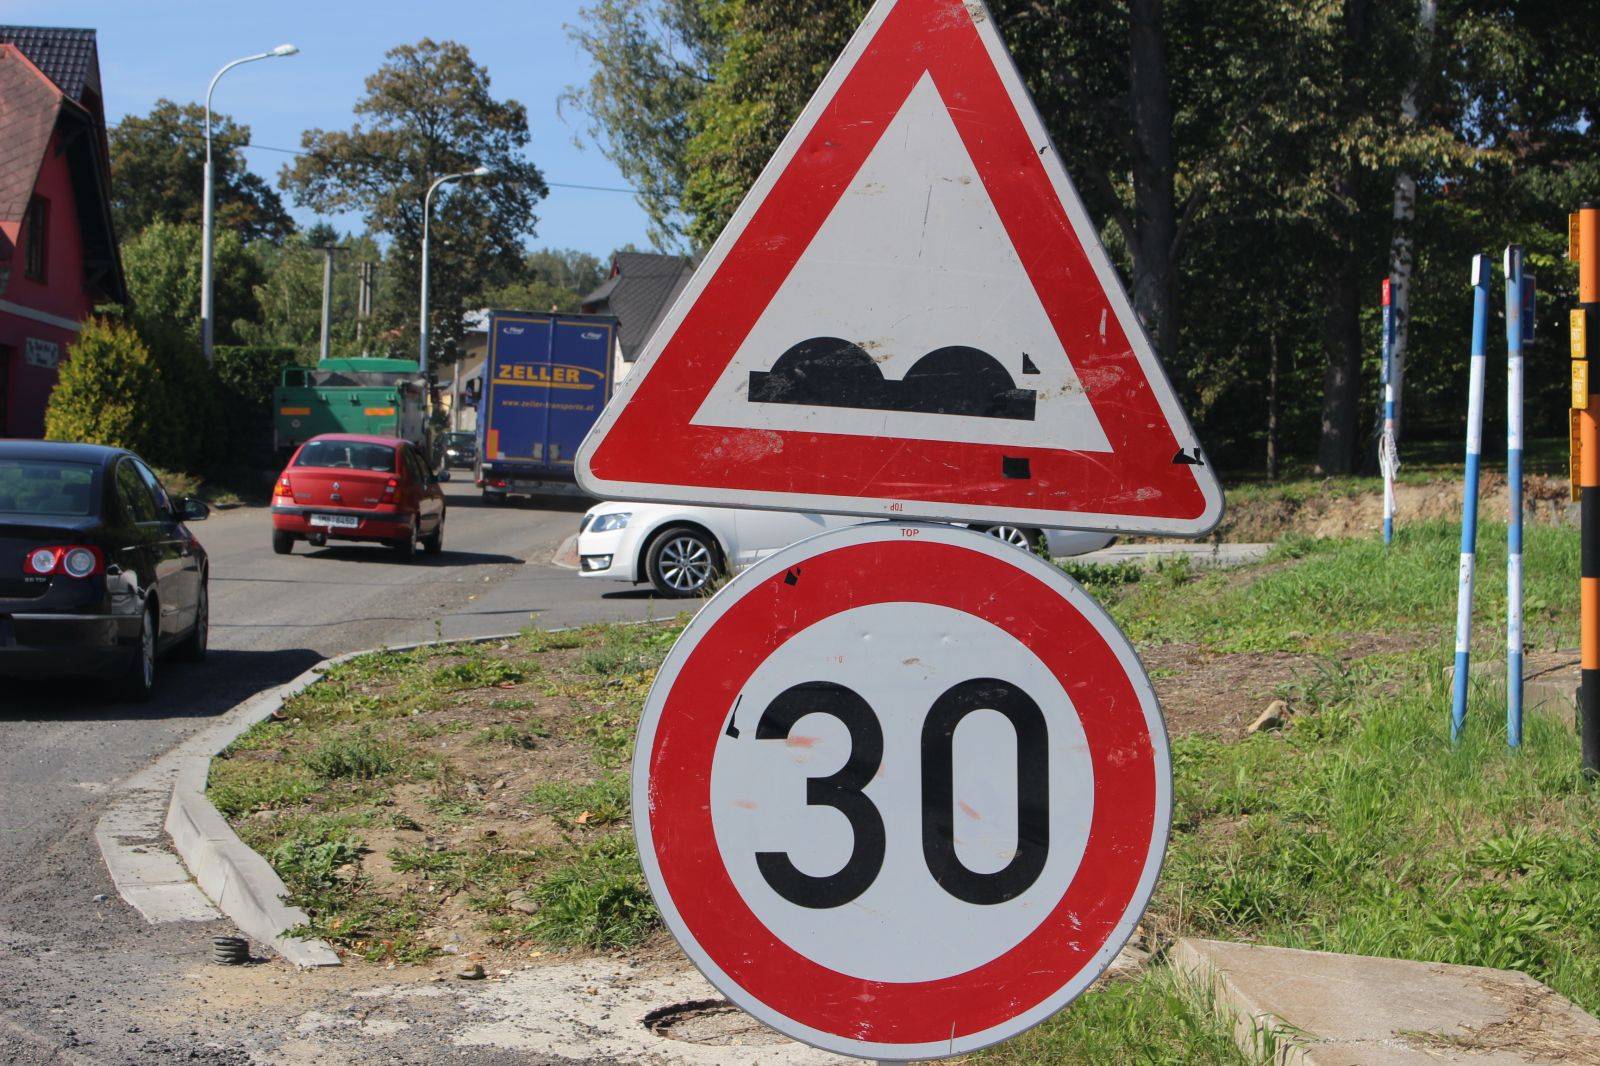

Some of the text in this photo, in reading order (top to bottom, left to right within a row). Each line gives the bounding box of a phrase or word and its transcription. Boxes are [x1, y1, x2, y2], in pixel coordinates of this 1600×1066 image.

[499, 364, 580, 383] ZELLER
[889, 502, 904, 512] TOP
[901, 528, 920, 537] TOP
[754, 677, 1050, 910] 30
